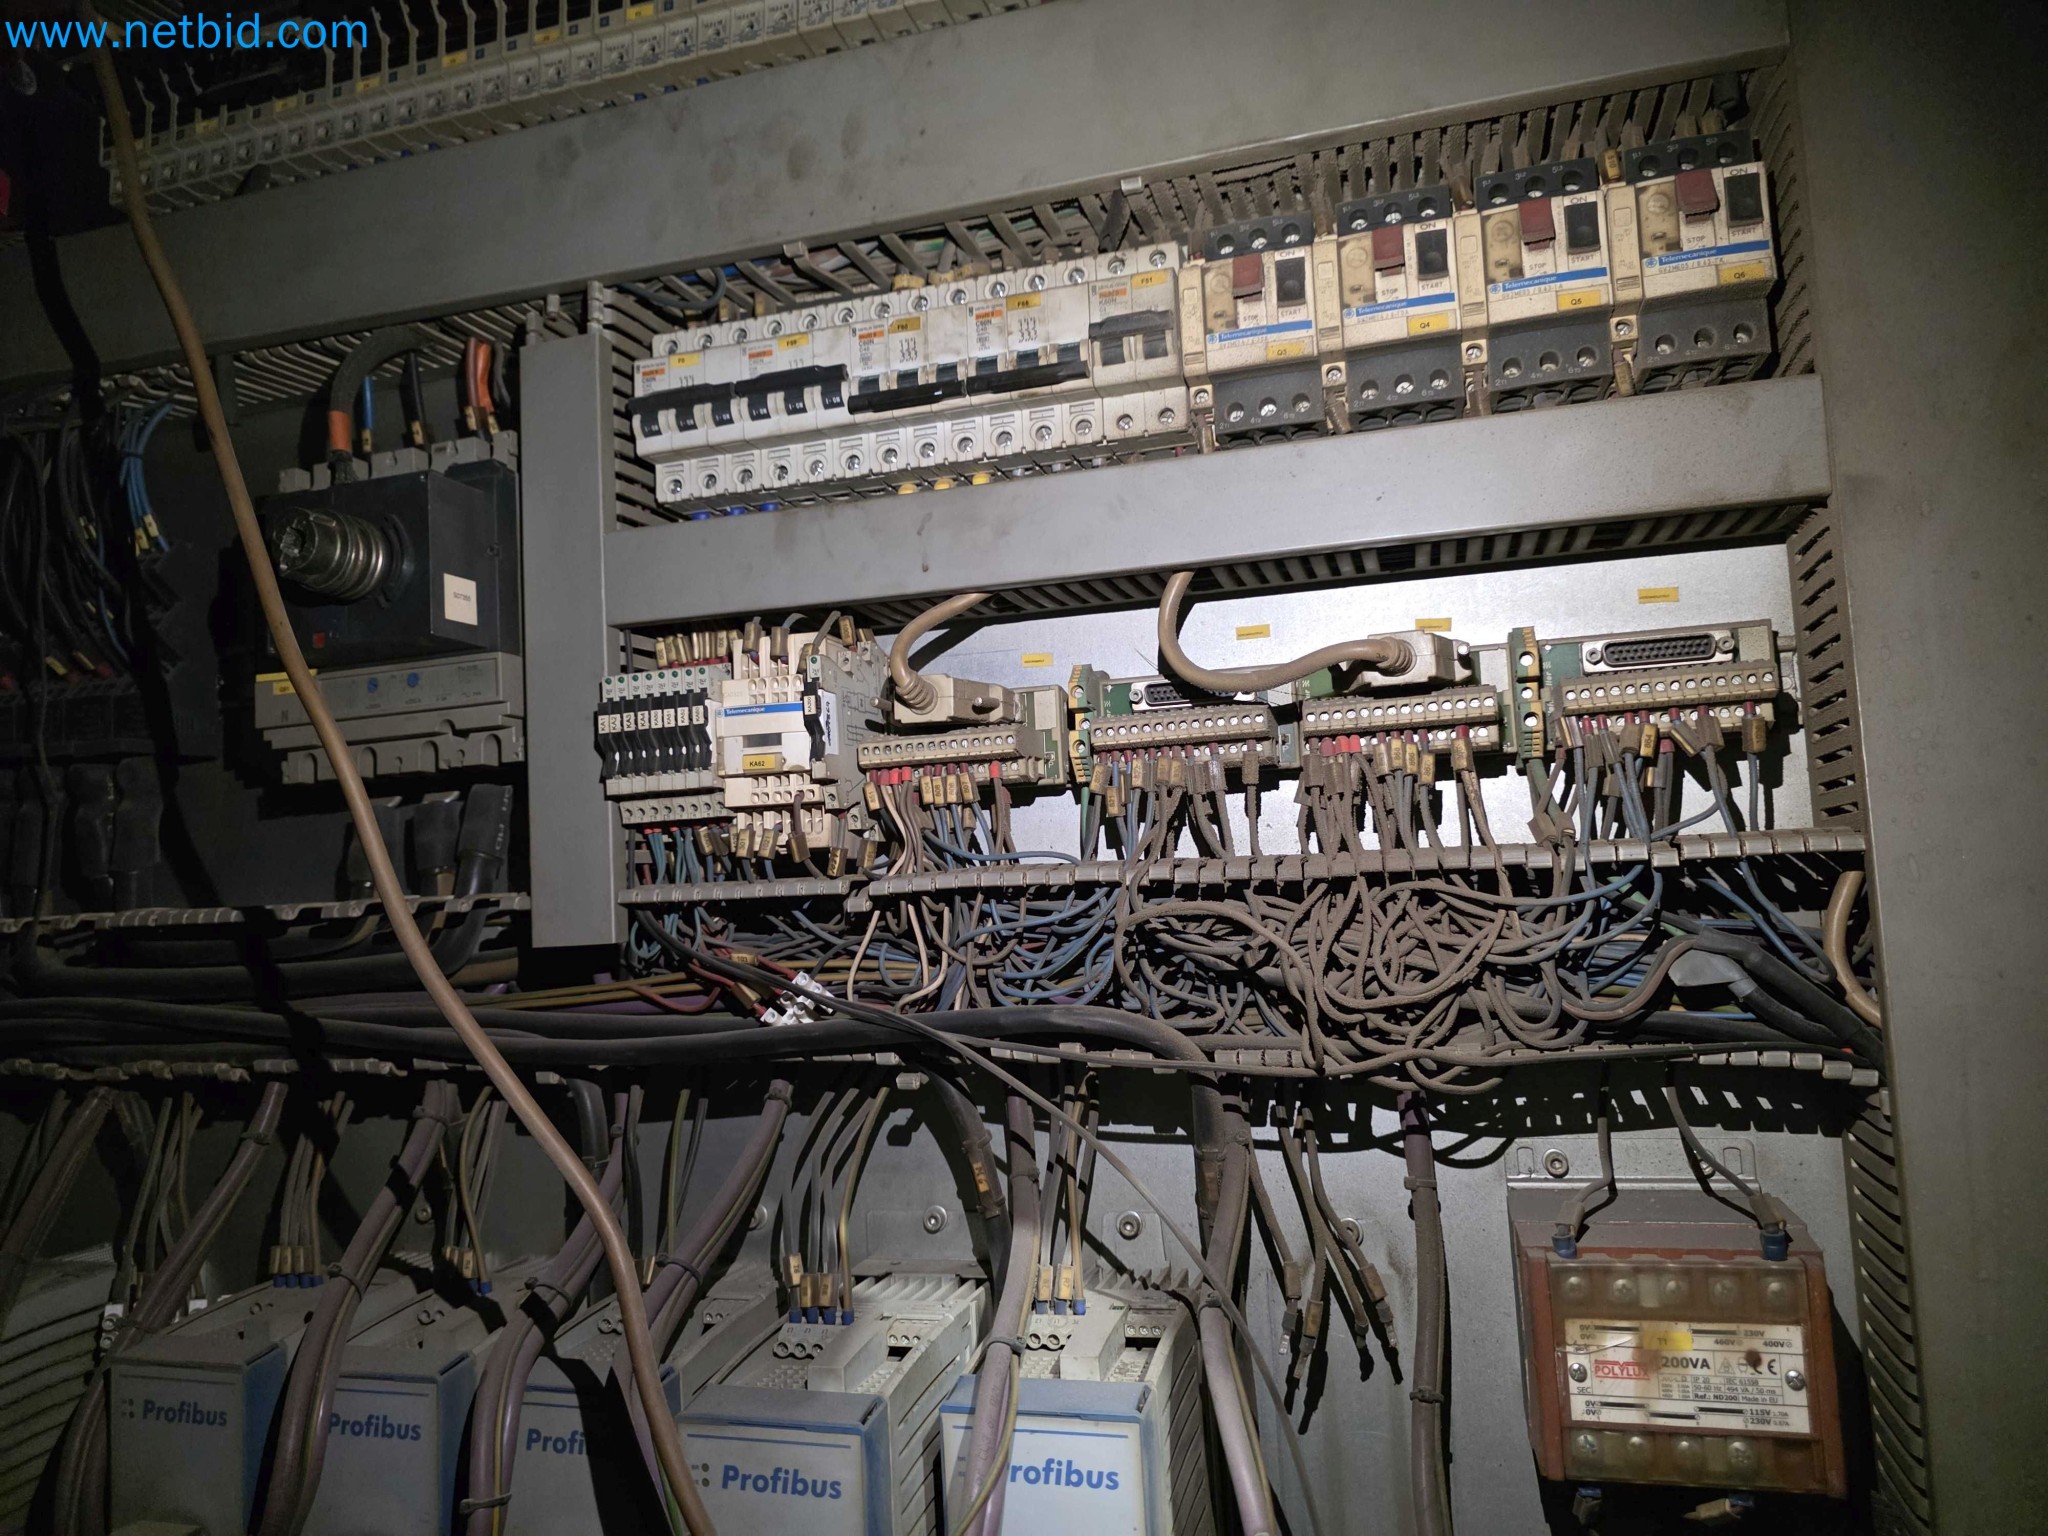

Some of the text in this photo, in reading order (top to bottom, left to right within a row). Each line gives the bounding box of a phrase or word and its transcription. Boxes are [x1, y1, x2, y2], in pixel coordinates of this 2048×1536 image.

[1730, 167, 1749, 176] ON
[1570, 195, 1588, 204] ON
[1420, 222, 1437, 230] ON
[1731, 228, 1756, 237] START
[1687, 236, 1705, 244] STOP
[1280, 250, 1295, 258] ON
[1661, 249, 1717, 263] Telemecanique
[1571, 254, 1594, 264] START
[1529, 263, 1547, 271] STOP
[1734, 271, 1746, 280] Q6
[1421, 281, 1443, 291] START
[1504, 275, 1557, 290] Telemecanique
[1381, 288, 1398, 296] STOP
[1570, 298, 1582, 306] Q5
[1280, 309, 1300, 317] START
[1419, 321, 1431, 329] Q4
[1276, 348, 1287, 356] Q3
[726, 706, 766, 715] Telemecanique
[1661, 1356, 1711, 1370] 200VA
[1576, 1386, 1591, 1394] SEC
[1694, 1392, 1711, 1400] Ref.:
[142, 1401, 228, 1427] Profibus
[1749, 1417, 1771, 1425] 230V
[328, 1411, 422, 1442] Profibus
[525, 1428, 585, 1456] Profi
[1009, 1456, 1120, 1491] rofibus
[721, 1462, 843, 1501] Profibus
